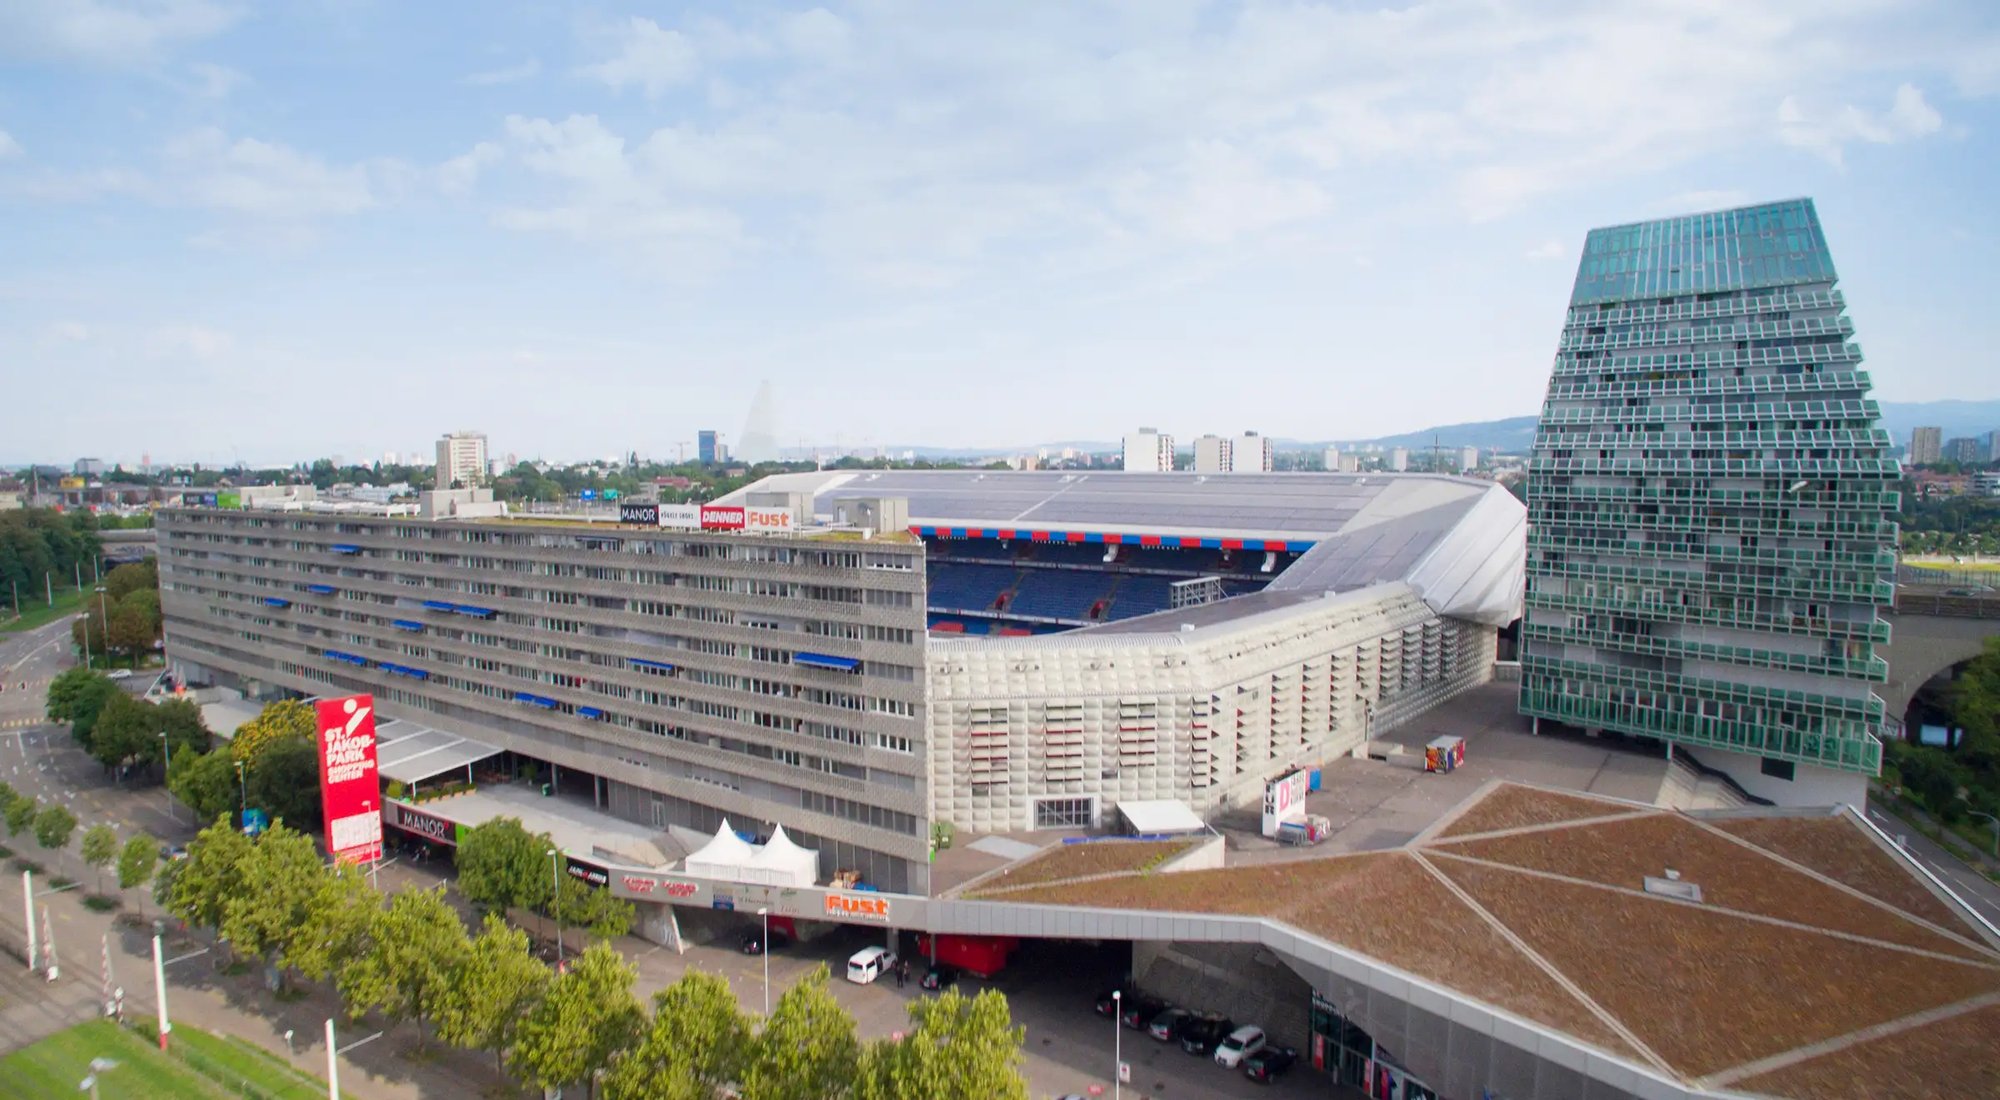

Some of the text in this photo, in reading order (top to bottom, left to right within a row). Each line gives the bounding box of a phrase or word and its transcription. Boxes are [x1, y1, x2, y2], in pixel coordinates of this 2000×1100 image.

[621, 507, 655, 523] MANOR
[702, 510, 743, 524] DENNER
[748, 511, 789, 528] Fust
[325, 727, 346, 743] ST.
[326, 734, 376, 755] JAKOB-
[327, 748, 366, 768] PARK
[328, 758, 375, 776] SHOPPING
[328, 767, 364, 784] CENTER
[403, 812, 445, 838] MANOR
[824, 894, 890, 917] Fust
